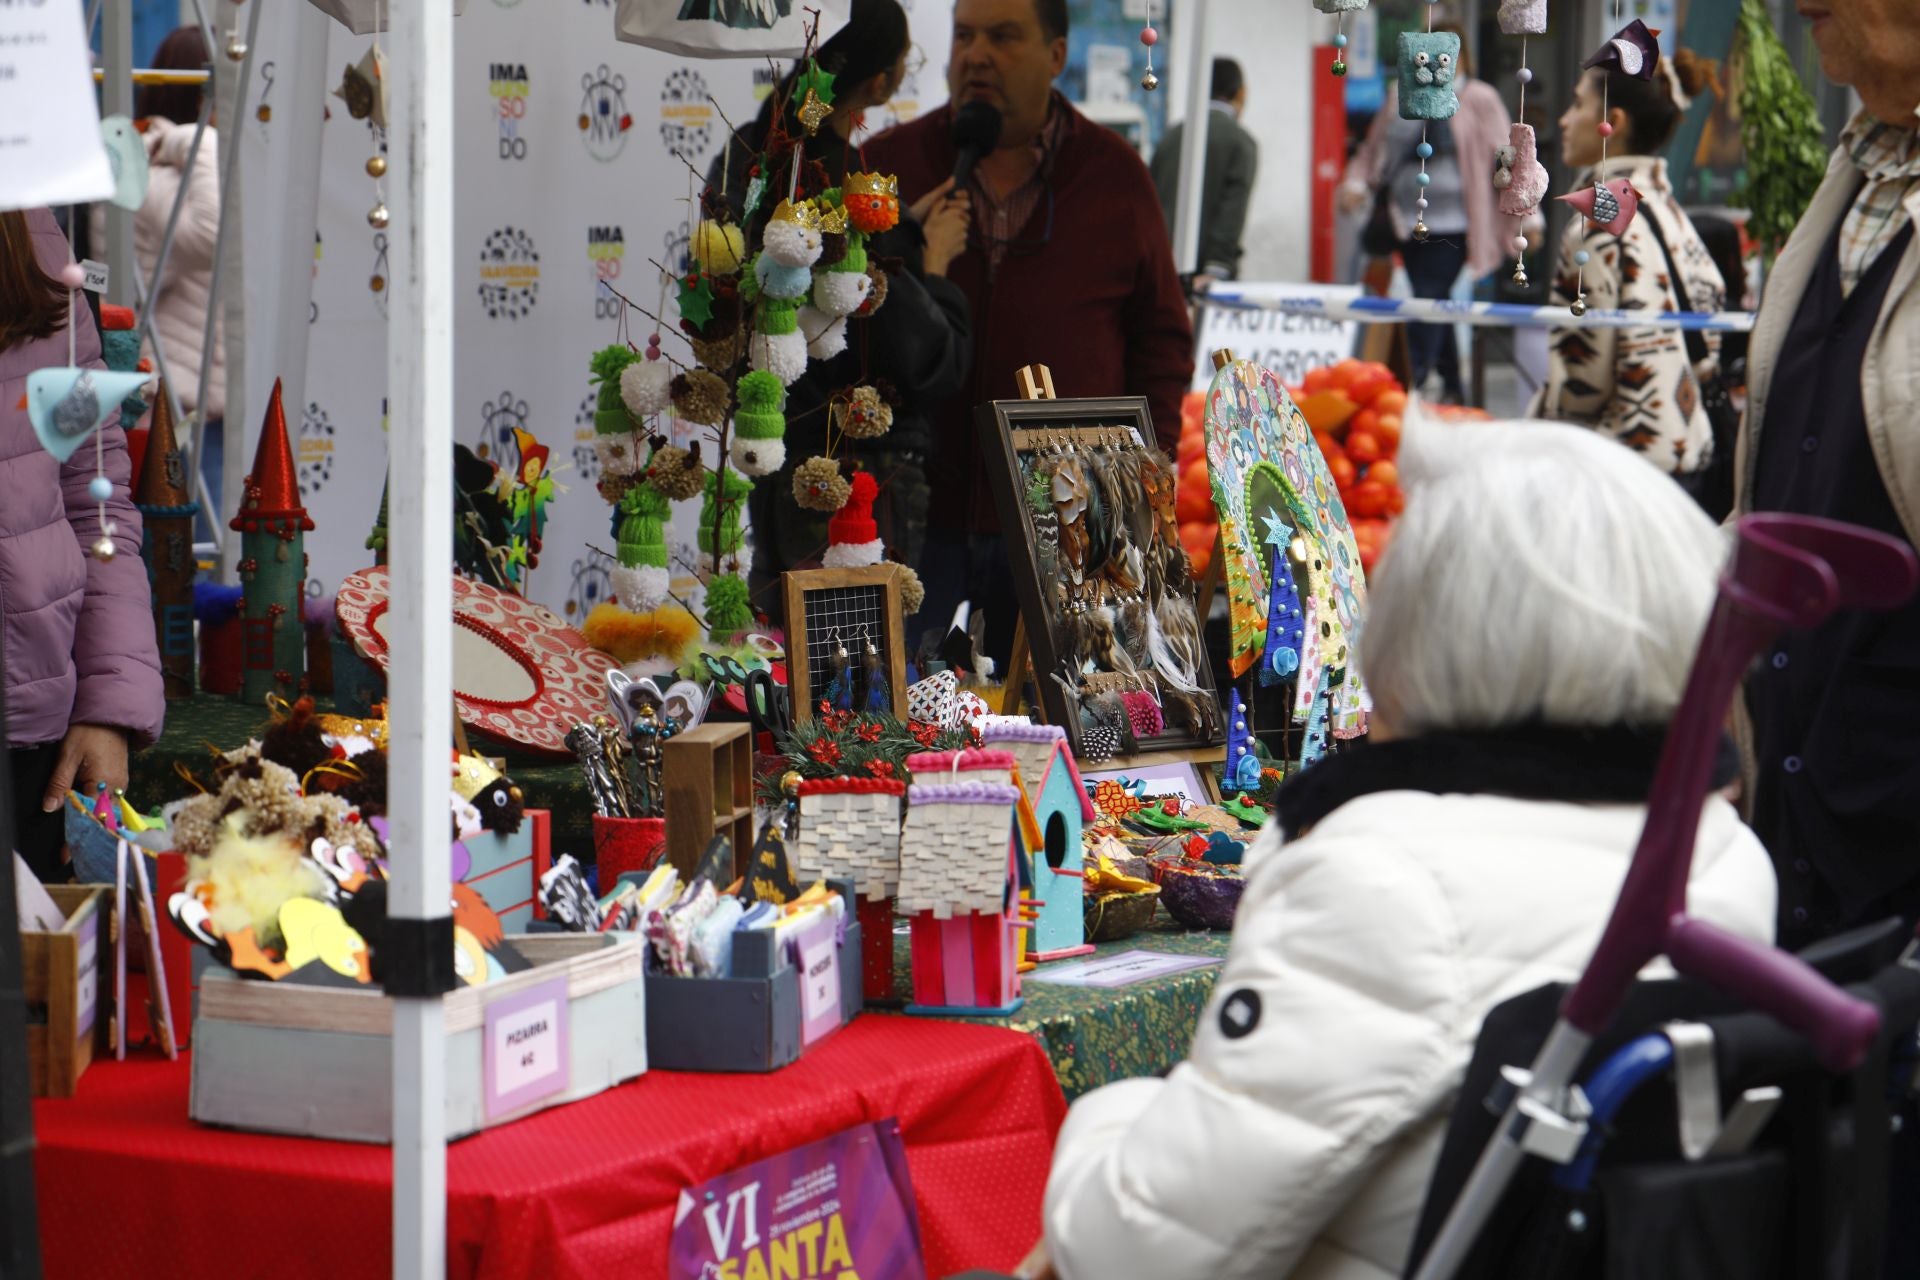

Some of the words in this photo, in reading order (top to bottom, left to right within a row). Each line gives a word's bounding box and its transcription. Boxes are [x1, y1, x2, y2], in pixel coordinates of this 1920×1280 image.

[489, 64, 528, 81] IMA
[499, 96, 526, 119] SO
[499, 137, 527, 161] DO
[588, 226, 624, 243] IMA
[596, 257, 621, 279] SO
[595, 297, 620, 319] DO
[703, 1181, 760, 1262] VI
